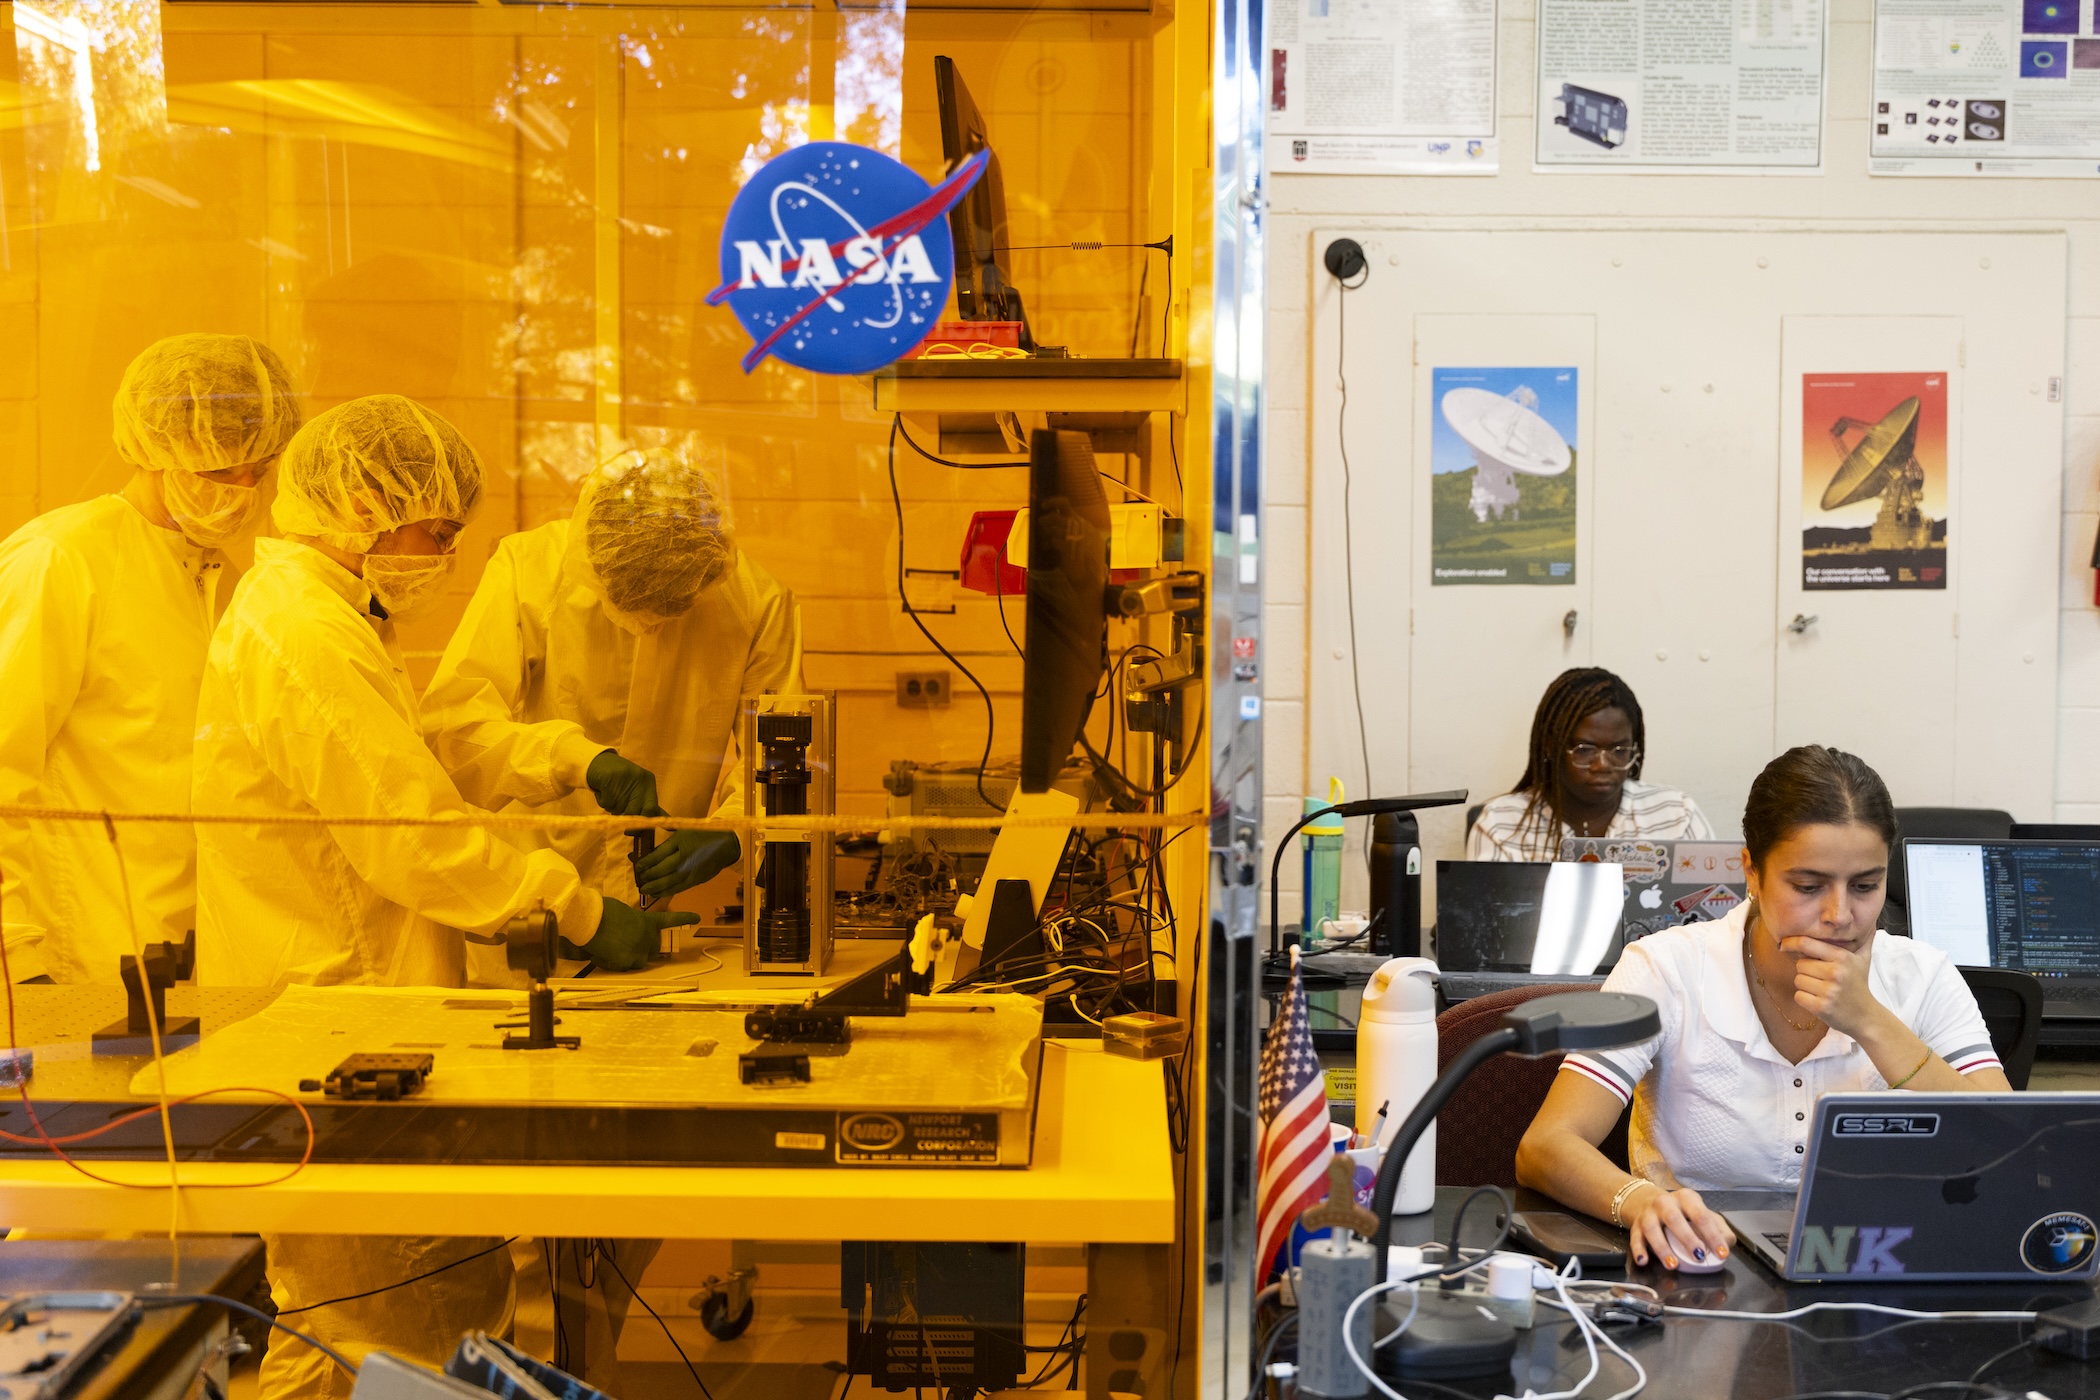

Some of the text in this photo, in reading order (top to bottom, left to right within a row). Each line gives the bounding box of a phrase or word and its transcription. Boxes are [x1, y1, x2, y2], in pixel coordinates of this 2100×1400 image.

[733, 234, 943, 289] NASA
[1435, 567, 1507, 578] Exploration enabled
[1805, 566, 1886, 575] Our conversation with
[908, 1115, 963, 1126] NEWPORT
[1842, 1118, 1929, 1132] SSRL
[852, 1123, 896, 1140] NRC
[913, 1127, 971, 1138] RESEARCH
[917, 1139, 996, 1151] CORPORATION
